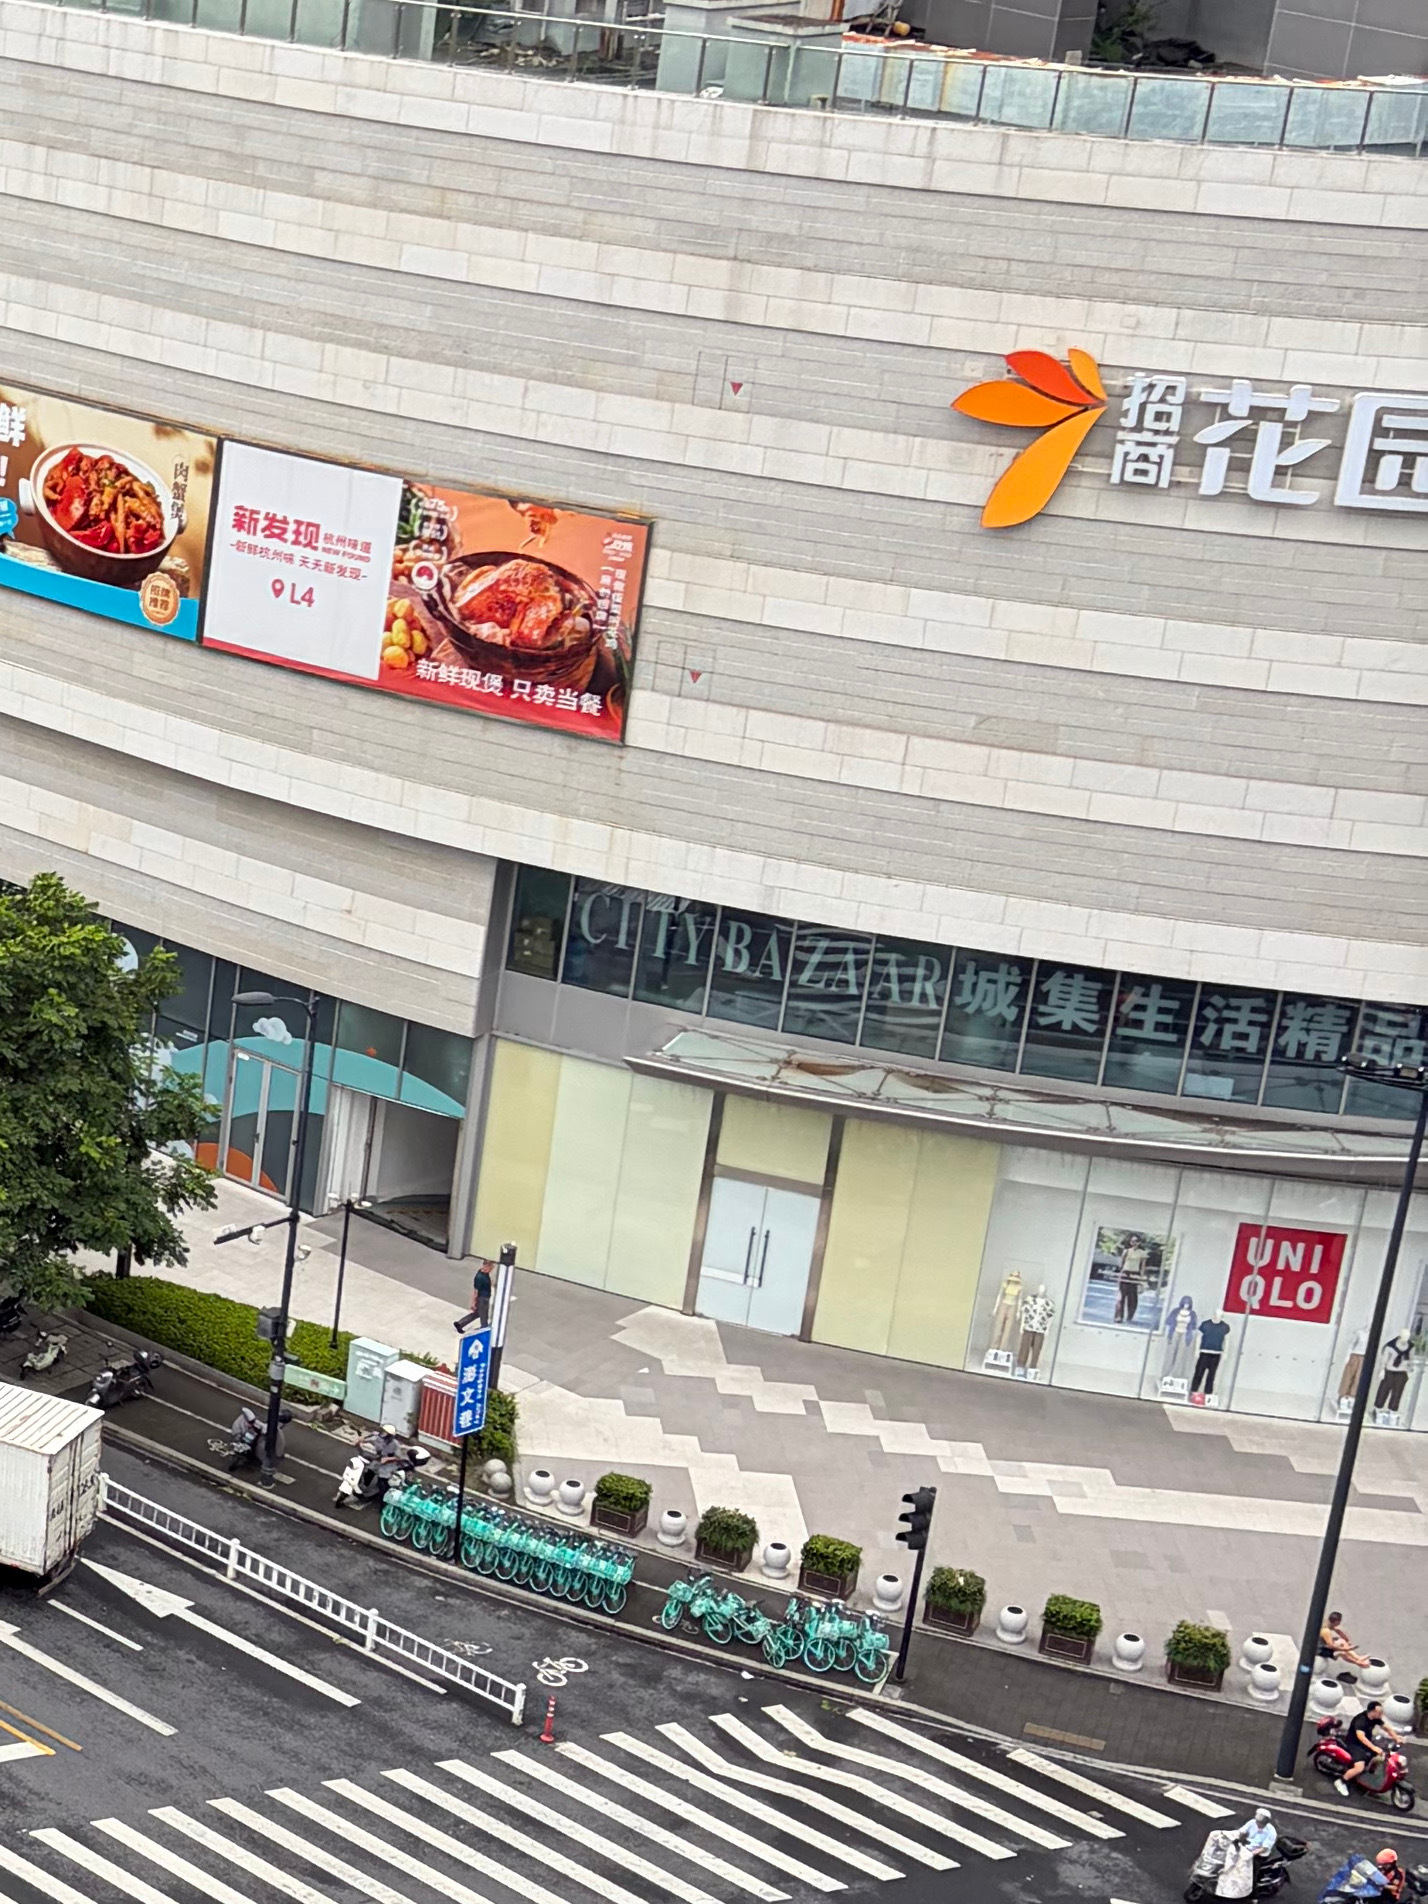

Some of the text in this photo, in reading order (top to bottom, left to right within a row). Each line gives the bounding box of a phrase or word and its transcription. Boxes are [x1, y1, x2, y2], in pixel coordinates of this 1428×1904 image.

[1113, 372, 1187, 488] 招商
[232, 505, 321, 551] 新发现
[290, 582, 315, 607] L4
[416, 659, 602, 716] 新鲜现煲 只卖当餐
[948, 960, 1428, 1069] 城集生活精品
[1246, 1236, 1324, 1274] UNI
[1239, 1273, 1323, 1310] QLO
